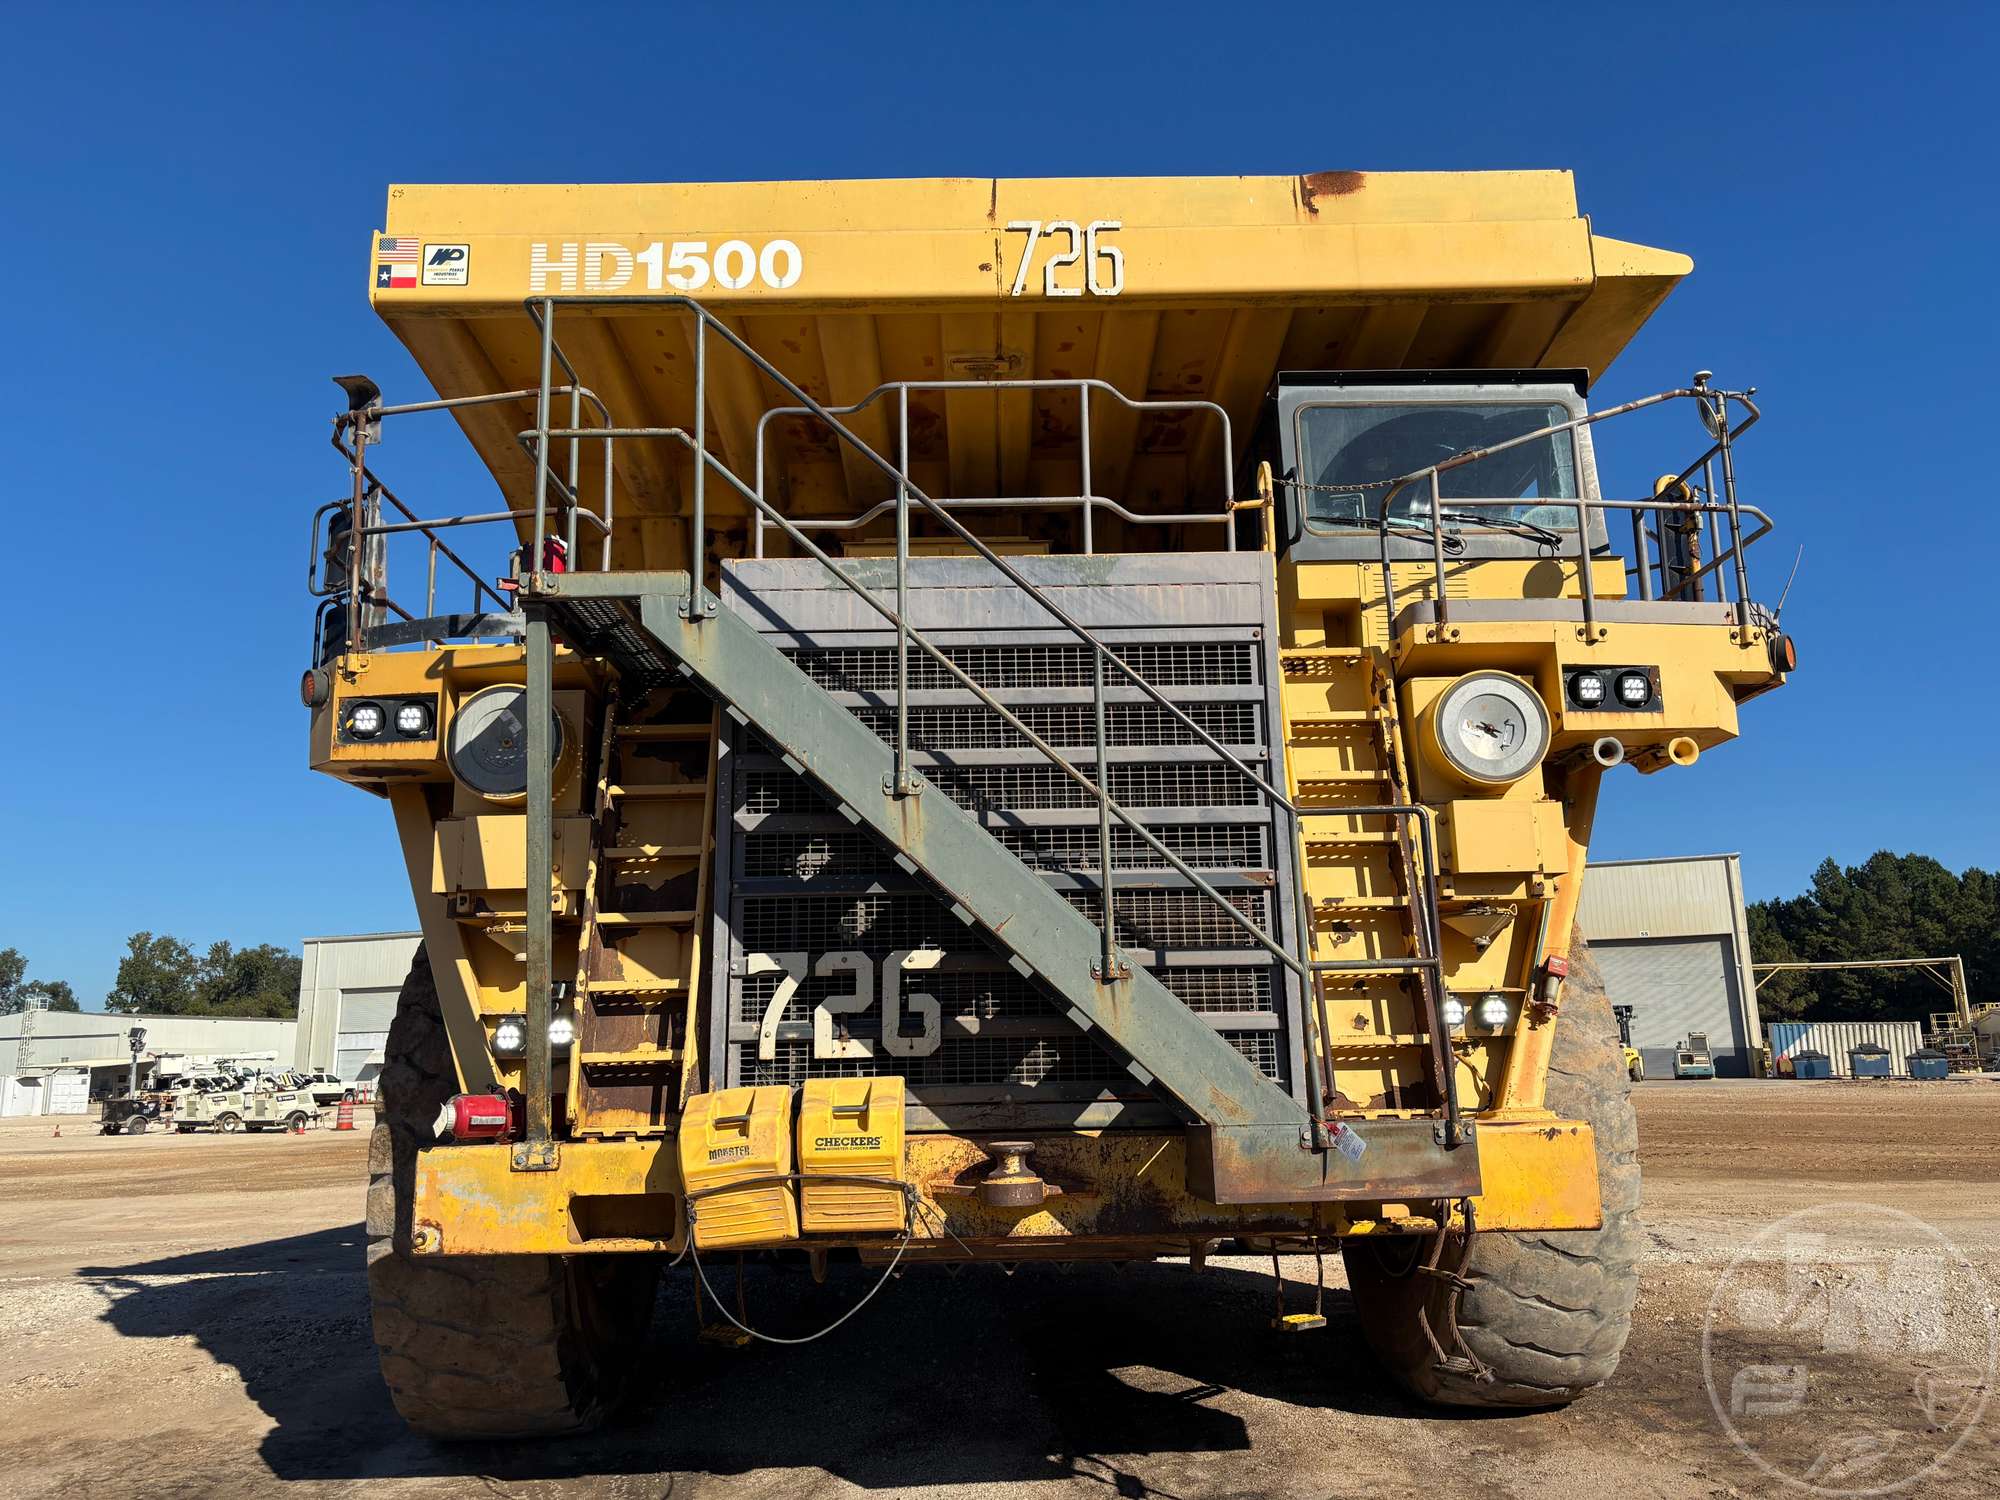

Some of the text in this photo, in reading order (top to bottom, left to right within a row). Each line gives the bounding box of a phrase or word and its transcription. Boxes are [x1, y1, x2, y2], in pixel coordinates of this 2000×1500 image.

[531, 239, 802, 291] HD1500
[1007, 220, 1124, 296] 726
[748, 950, 943, 1060] 726
[815, 1136, 880, 1147] CHECKERS
